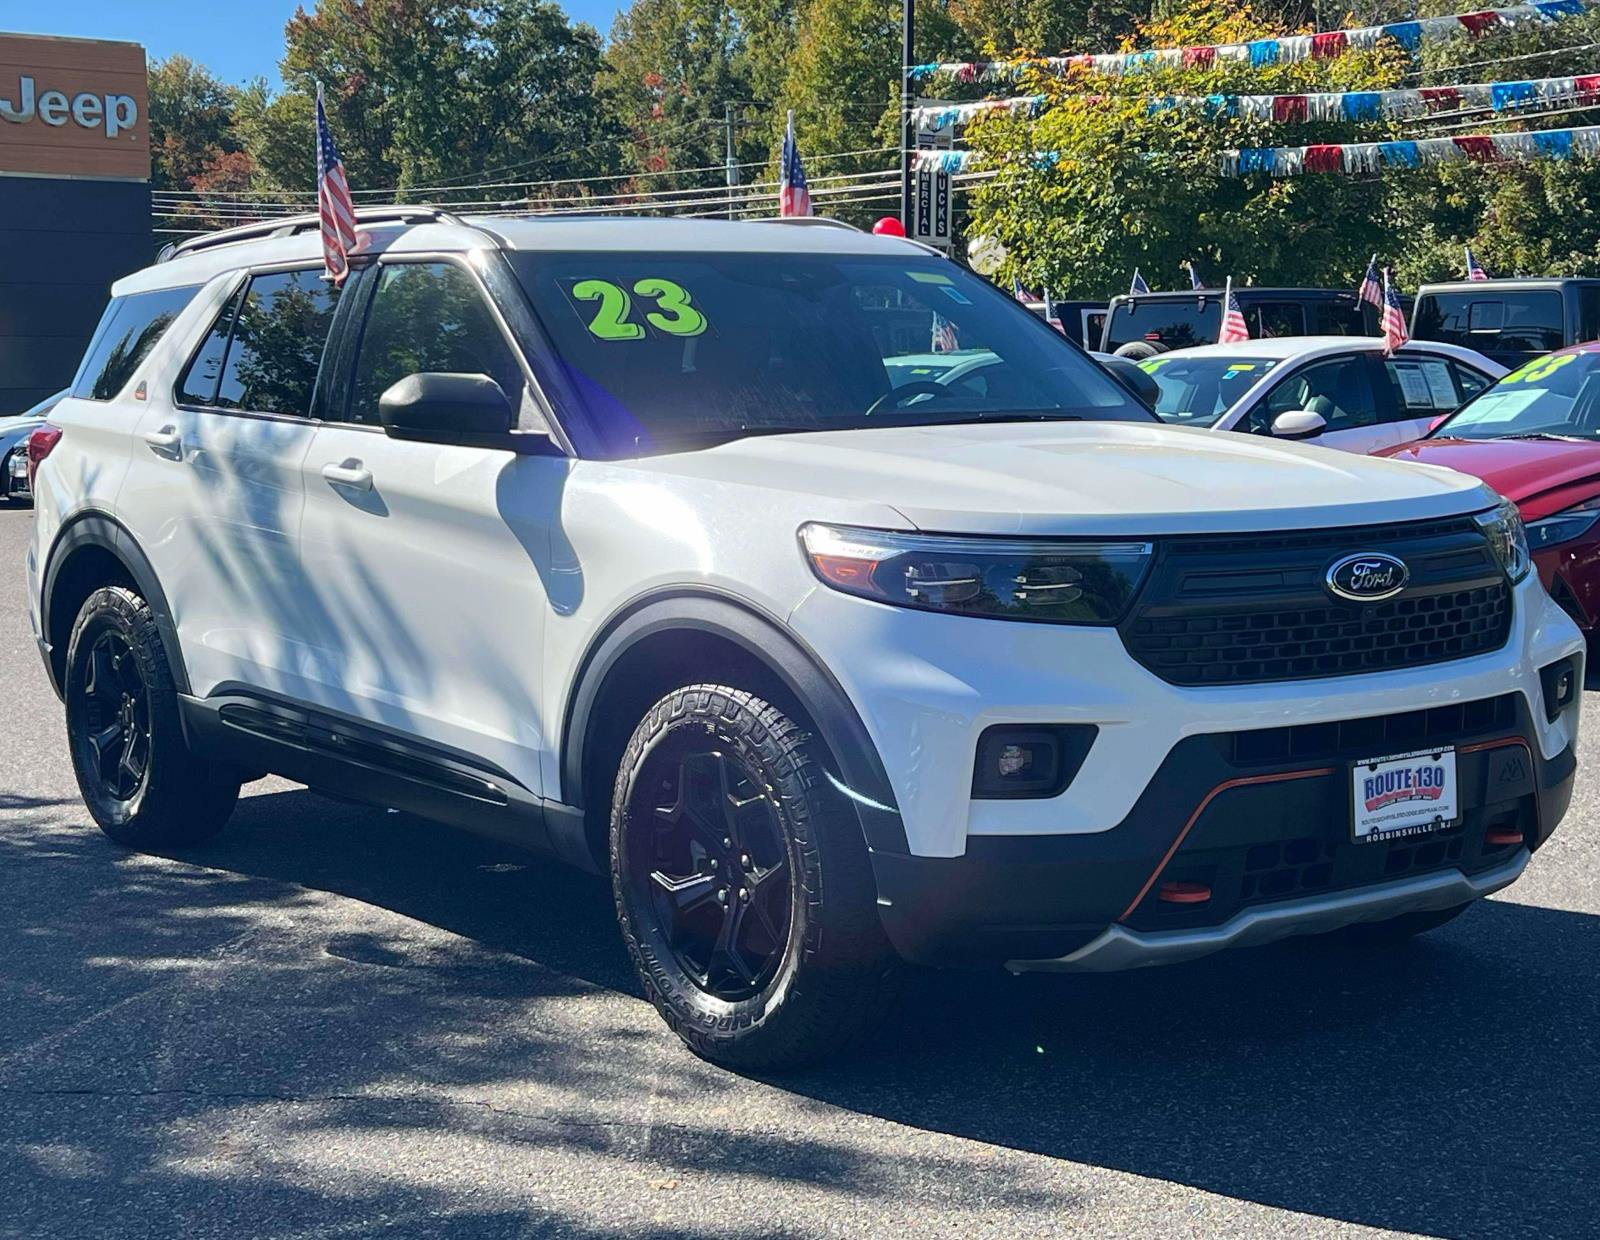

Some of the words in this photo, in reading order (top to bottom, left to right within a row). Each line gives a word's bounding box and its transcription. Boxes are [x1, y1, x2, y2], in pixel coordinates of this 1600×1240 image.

[0, 75, 138, 138] Jeep
[921, 147, 929, 234] MERCIAL
[938, 167, 946, 234] RUCKS
[572, 278, 708, 341] 23
[1350, 562, 1394, 590] Ford
[1363, 768, 1412, 801] ROUTE
[1415, 766, 1445, 788] 130
[1441, 821, 1451, 830] NJ
